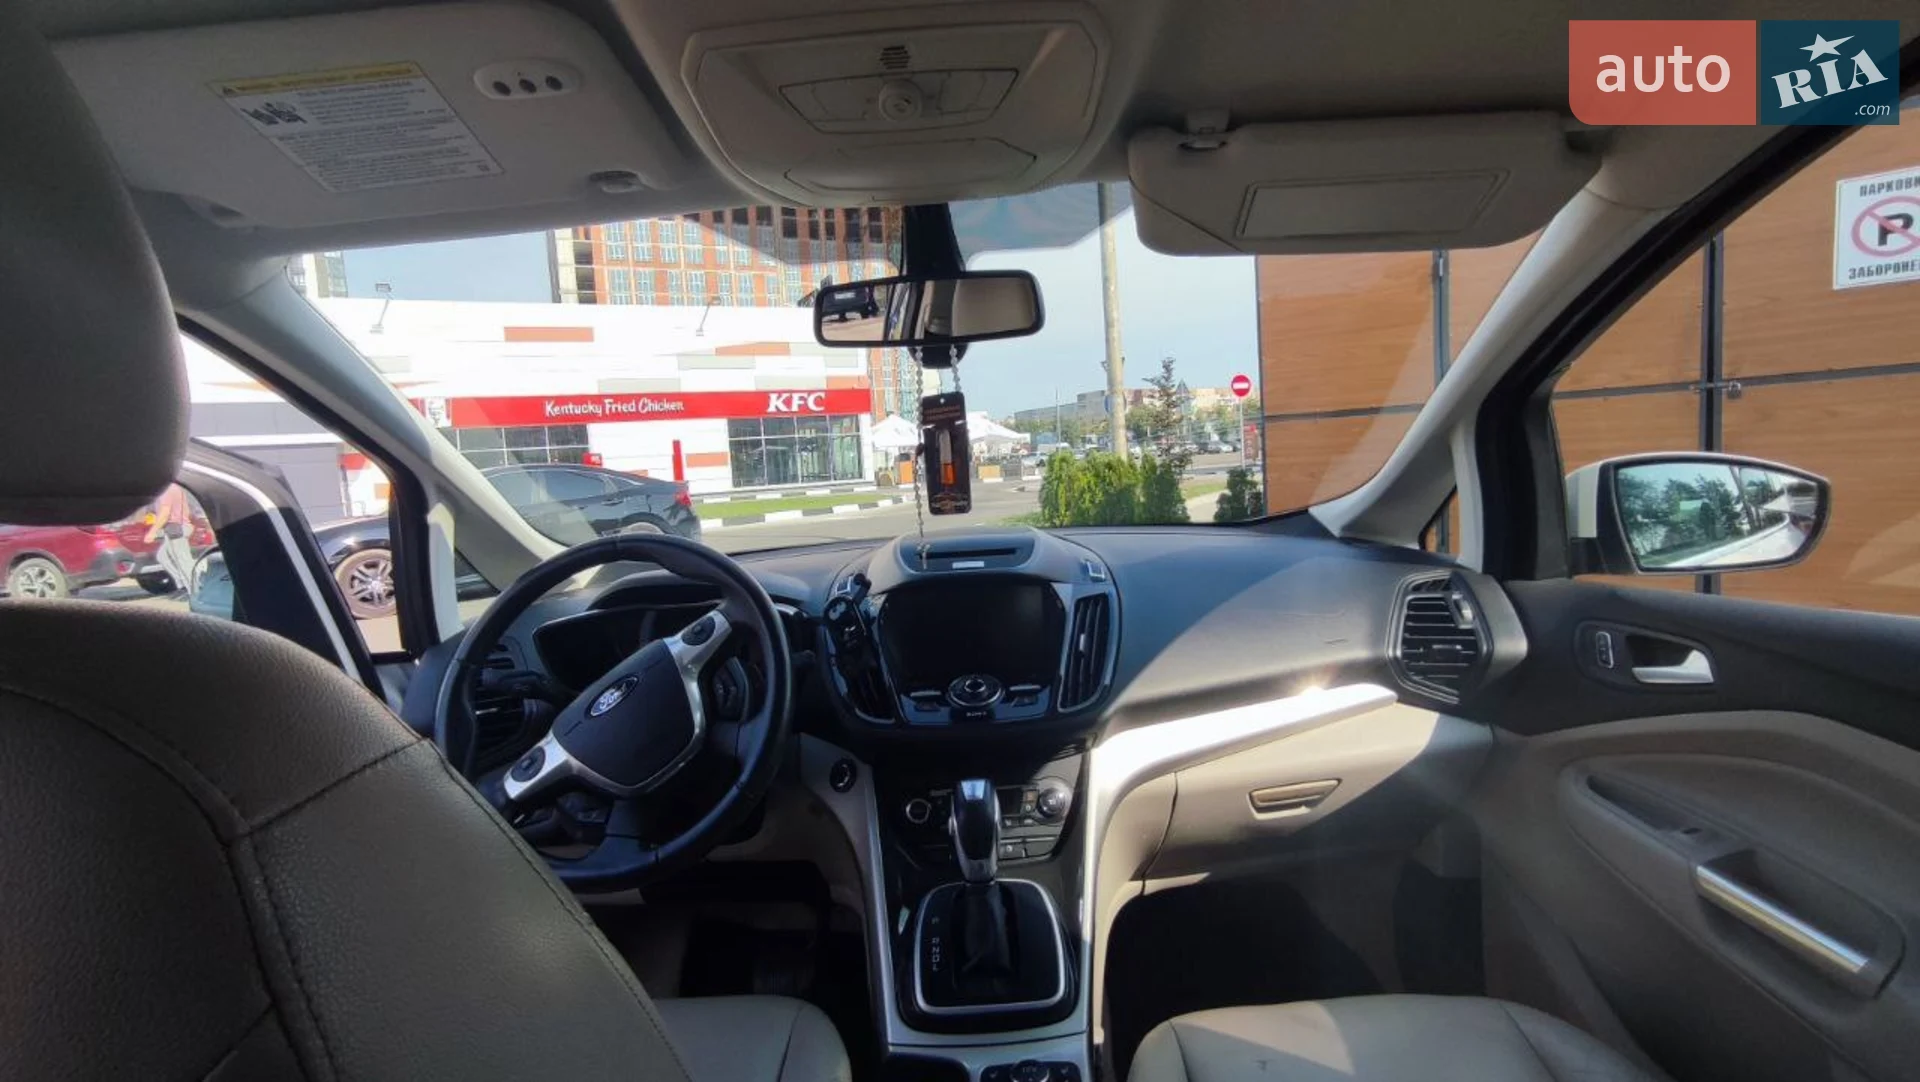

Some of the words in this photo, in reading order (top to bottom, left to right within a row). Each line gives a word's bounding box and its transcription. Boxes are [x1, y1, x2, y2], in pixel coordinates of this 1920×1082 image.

[1848, 259, 1920, 280] ЗАБОРОНЕ
[545, 400, 602, 417] Kentucky
[603, 398, 636, 415] Fried
[638, 397, 685, 414] Chicken
[767, 391, 826, 413] KFC
